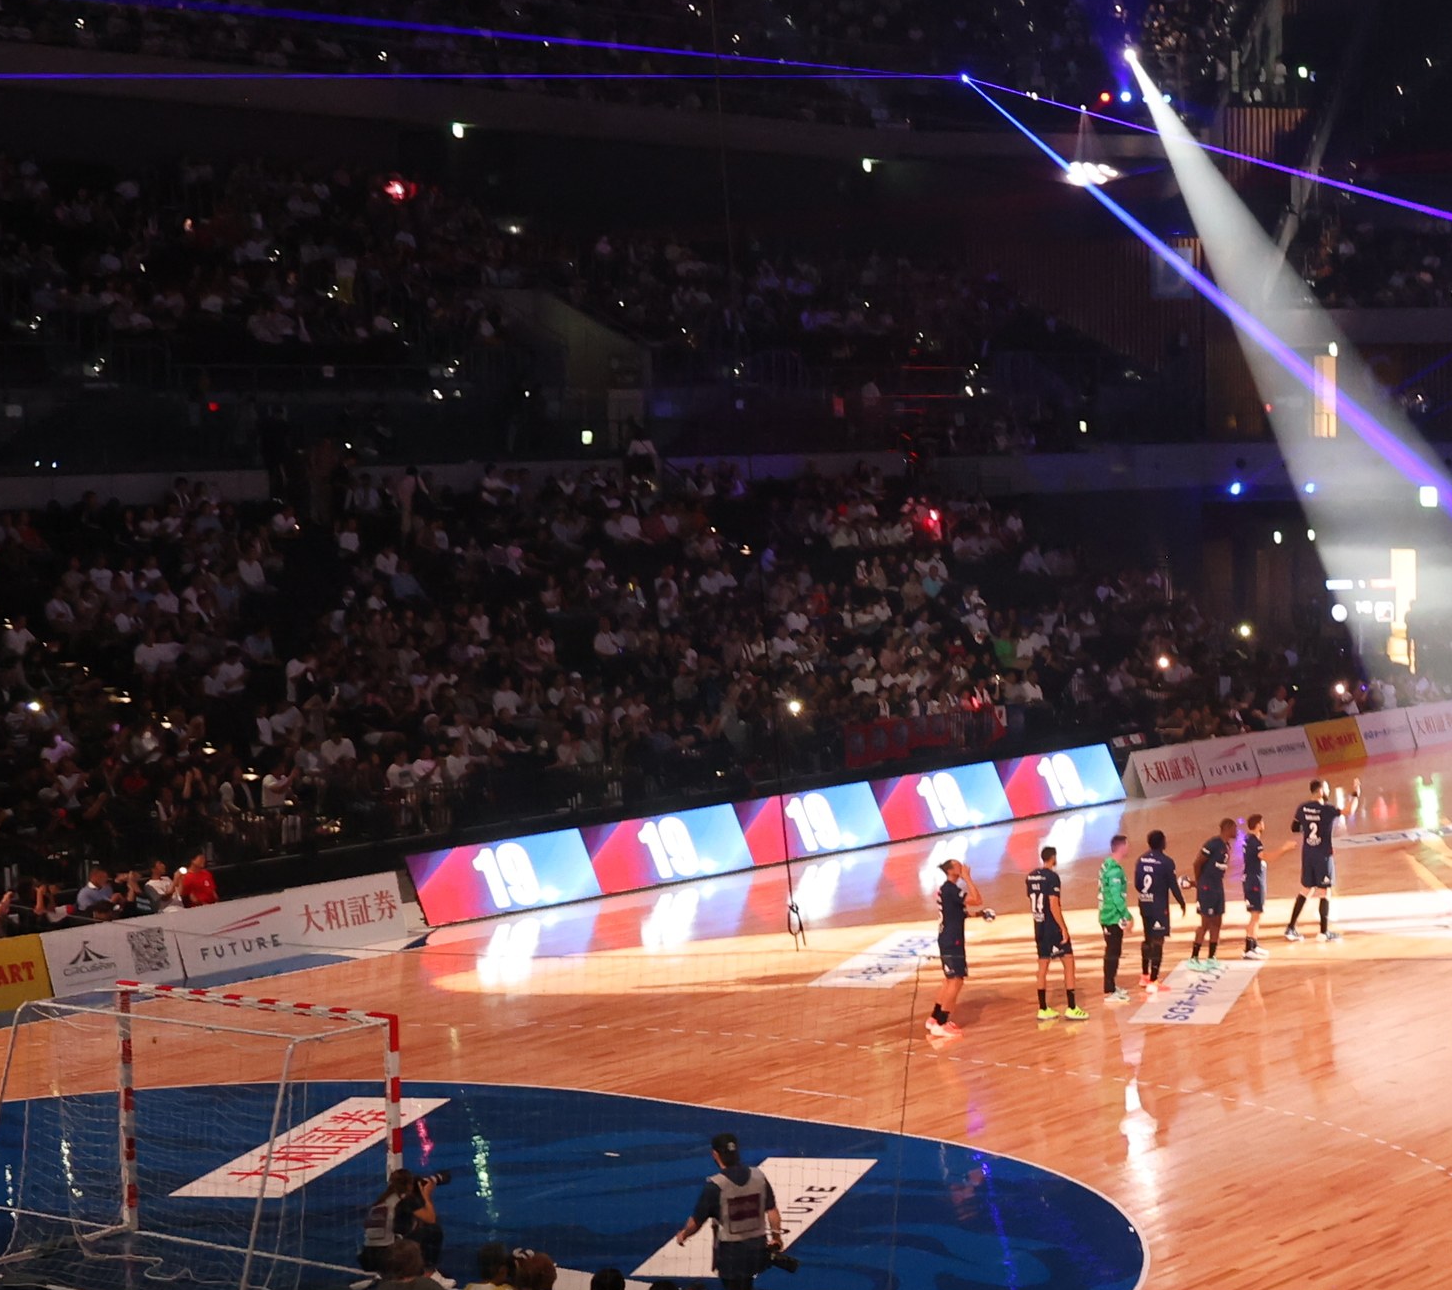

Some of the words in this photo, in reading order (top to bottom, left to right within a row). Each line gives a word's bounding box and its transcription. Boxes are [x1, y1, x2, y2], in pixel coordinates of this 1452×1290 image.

[1037, 753, 1086, 807] 19
[1141, 755, 1196, 784] 大和証券
[1209, 760, 1248, 778] FUTURE
[916, 772, 968, 829] 19
[785, 793, 841, 852] 19
[1309, 822, 1318, 838] 2
[638, 816, 700, 879] 19
[472, 842, 541, 909] 19
[1142, 874, 1153, 894] 9
[298, 889, 398, 936] 大和証券
[1030, 892, 1044, 913] 14
[200, 933, 283, 961] FUTURE
